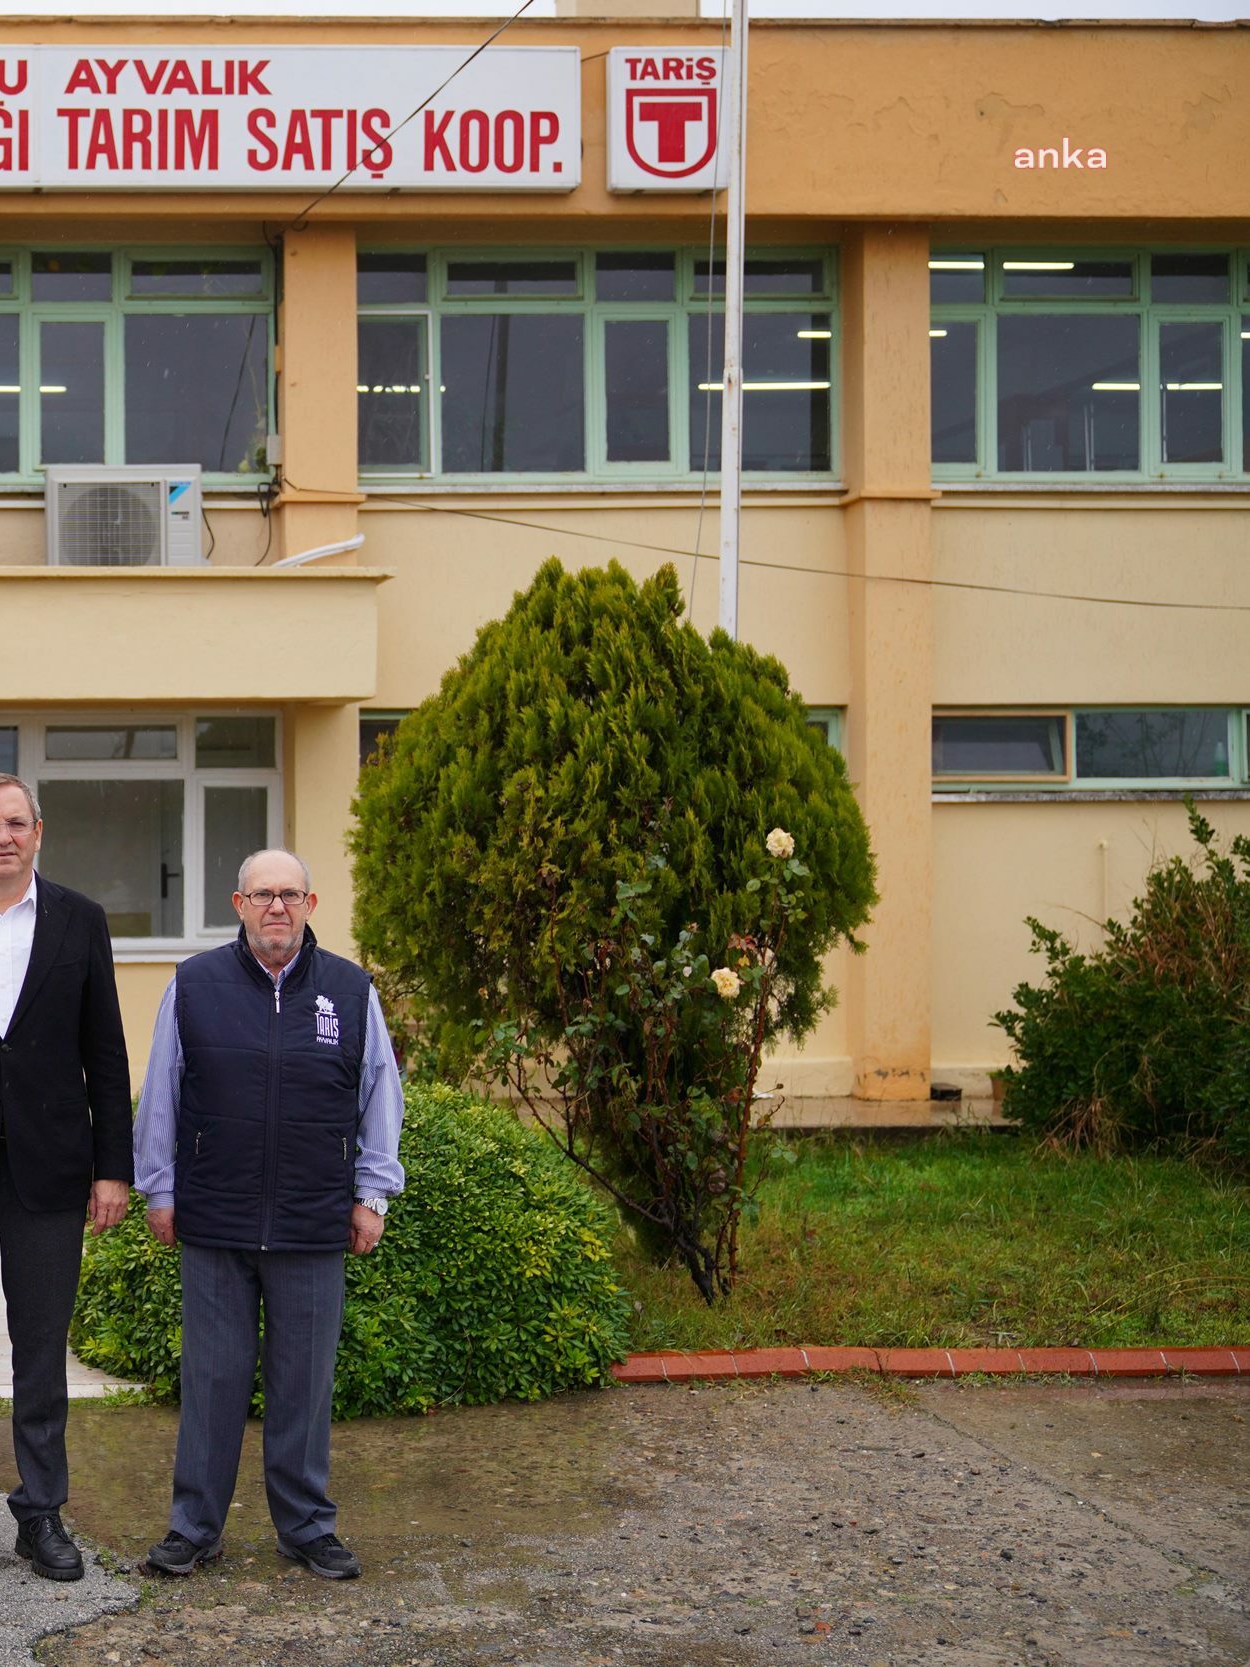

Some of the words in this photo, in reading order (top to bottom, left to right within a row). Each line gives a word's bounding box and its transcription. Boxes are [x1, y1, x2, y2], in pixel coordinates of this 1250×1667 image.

[64, 59, 271, 95] AYVALIK
[57, 108, 219, 171] TARIM
[247, 108, 393, 179] SATIŞ
[423, 109, 563, 173] KOOP.
[639, 102, 703, 162] T
